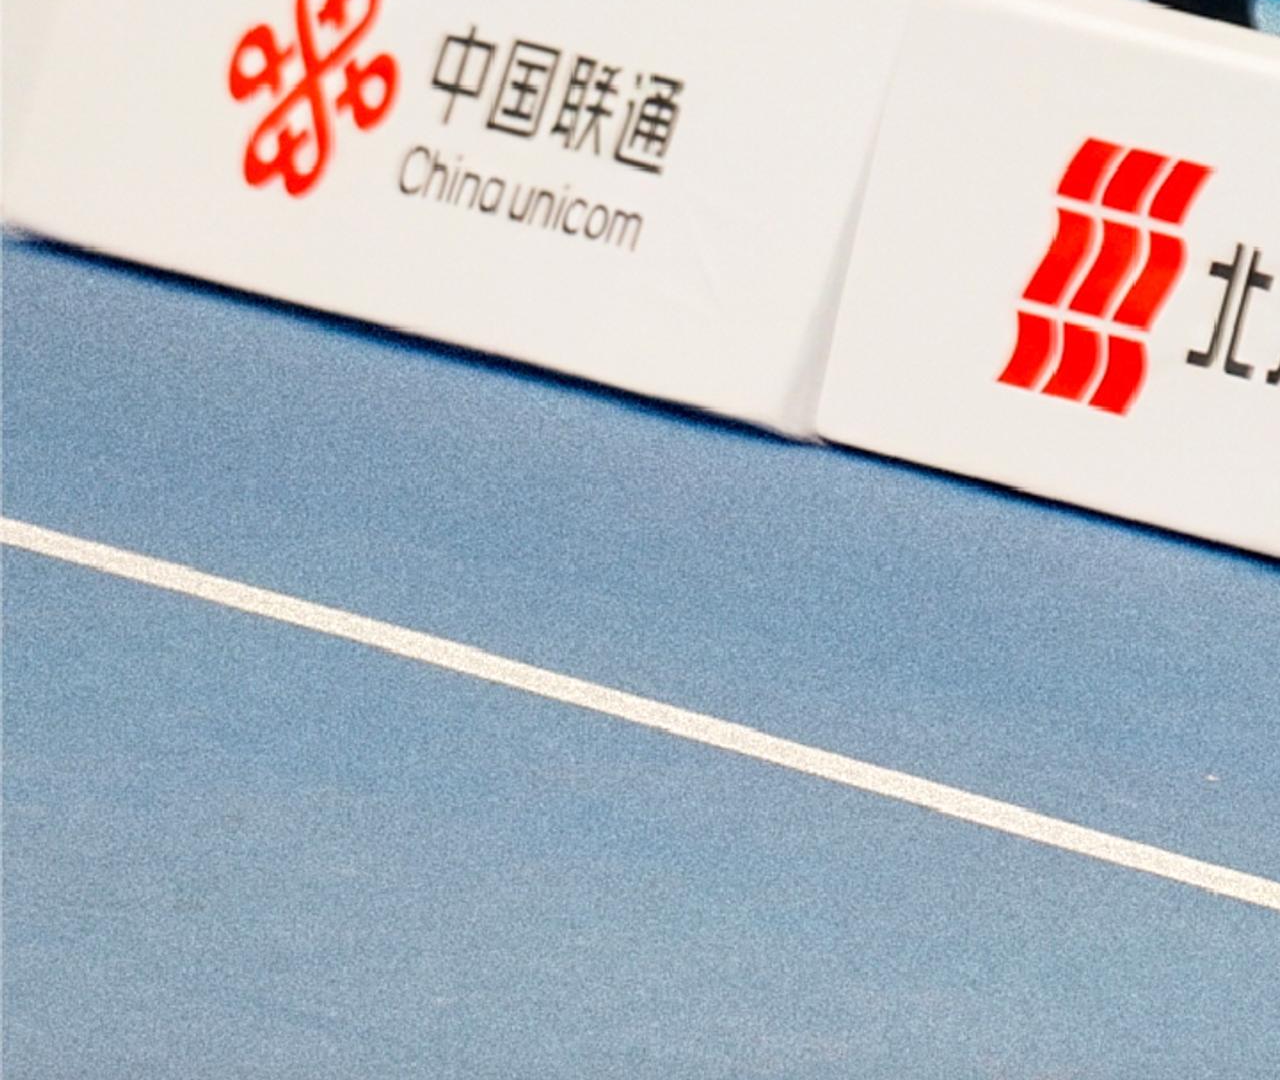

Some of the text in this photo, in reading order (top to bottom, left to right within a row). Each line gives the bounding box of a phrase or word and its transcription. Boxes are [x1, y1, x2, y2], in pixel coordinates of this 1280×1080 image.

[430, 25, 686, 176] 中国联通
[399, 145, 643, 252] China unicom
